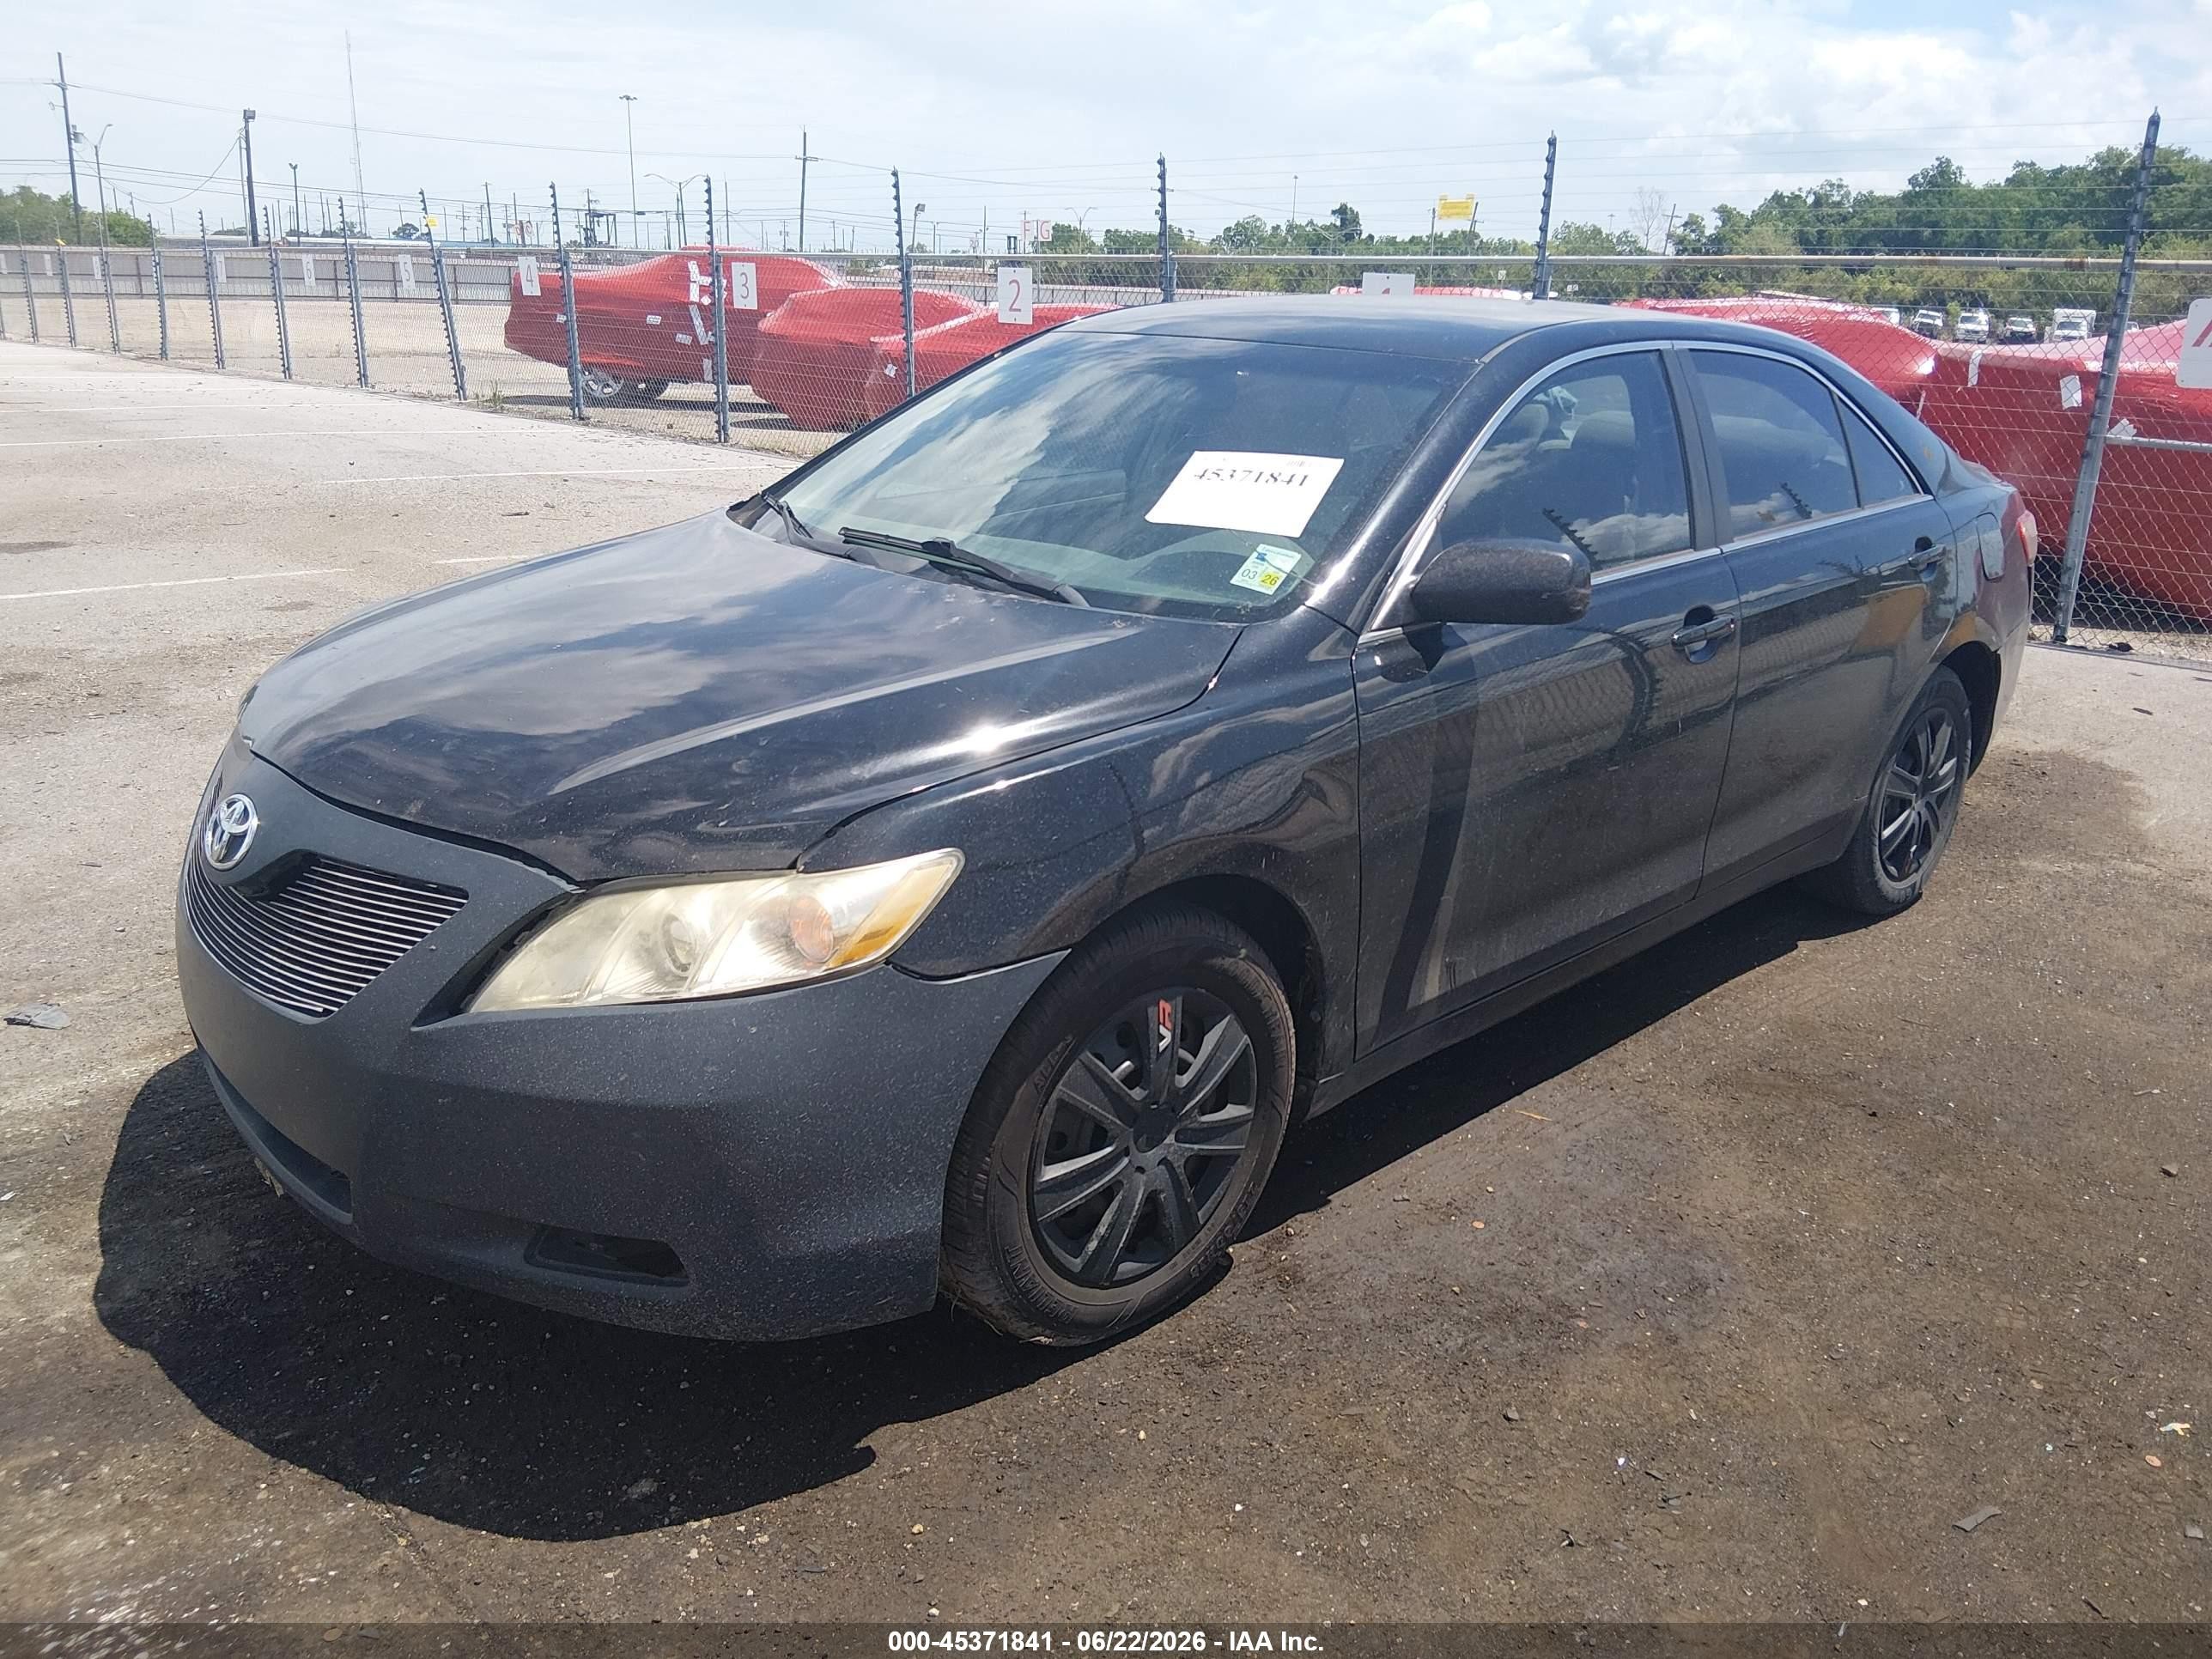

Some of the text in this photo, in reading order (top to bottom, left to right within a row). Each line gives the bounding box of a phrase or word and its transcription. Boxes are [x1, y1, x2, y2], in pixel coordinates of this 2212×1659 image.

[1040, 221, 1050, 240] G
[306, 262, 312, 279] 6
[404, 263, 410, 282] 5
[526, 264, 533, 288] 4
[740, 272, 750, 299] 3
[1008, 279, 1021, 312] 2
[1194, 468, 1309, 486] 45371841
[1242, 568, 1257, 580] 03
[1261, 574, 1279, 586] 26
